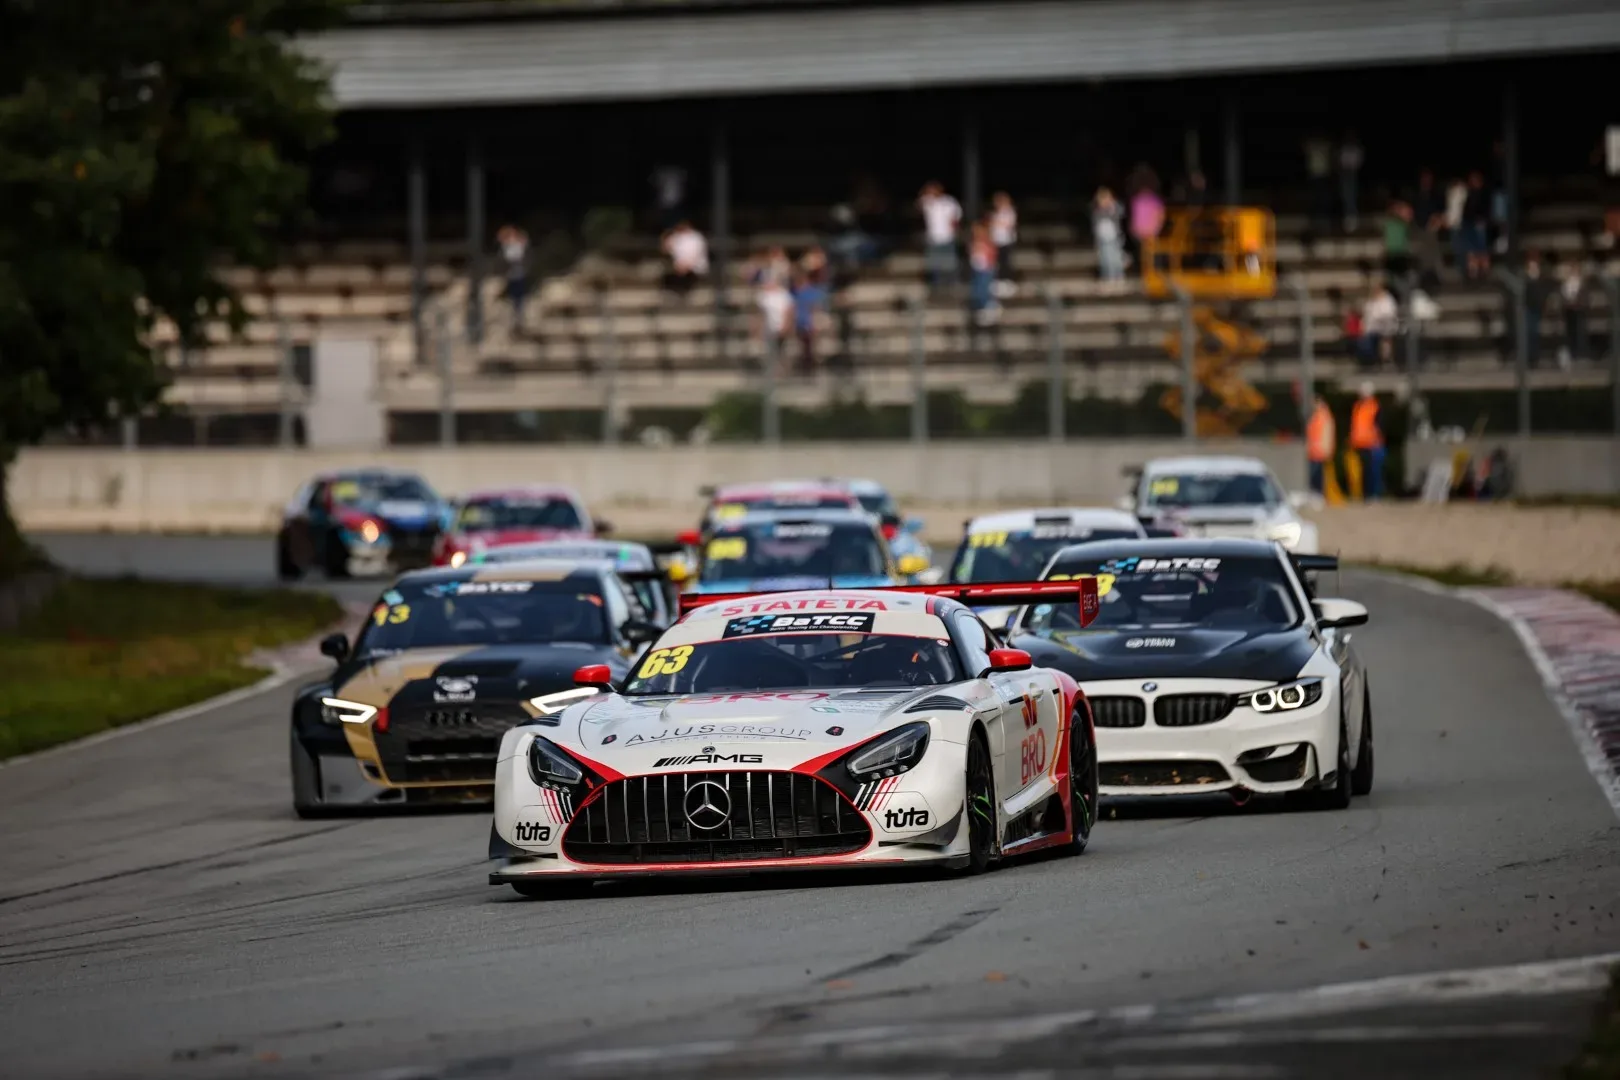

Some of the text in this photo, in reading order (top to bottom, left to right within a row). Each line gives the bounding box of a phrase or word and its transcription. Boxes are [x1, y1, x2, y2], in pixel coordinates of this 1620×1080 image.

[721, 600, 888, 616] STATETA
[772, 616, 868, 627] BaTCC
[638, 645, 694, 679] 63
[689, 754, 763, 764] AMG
[1021, 728, 1046, 785] BRO
